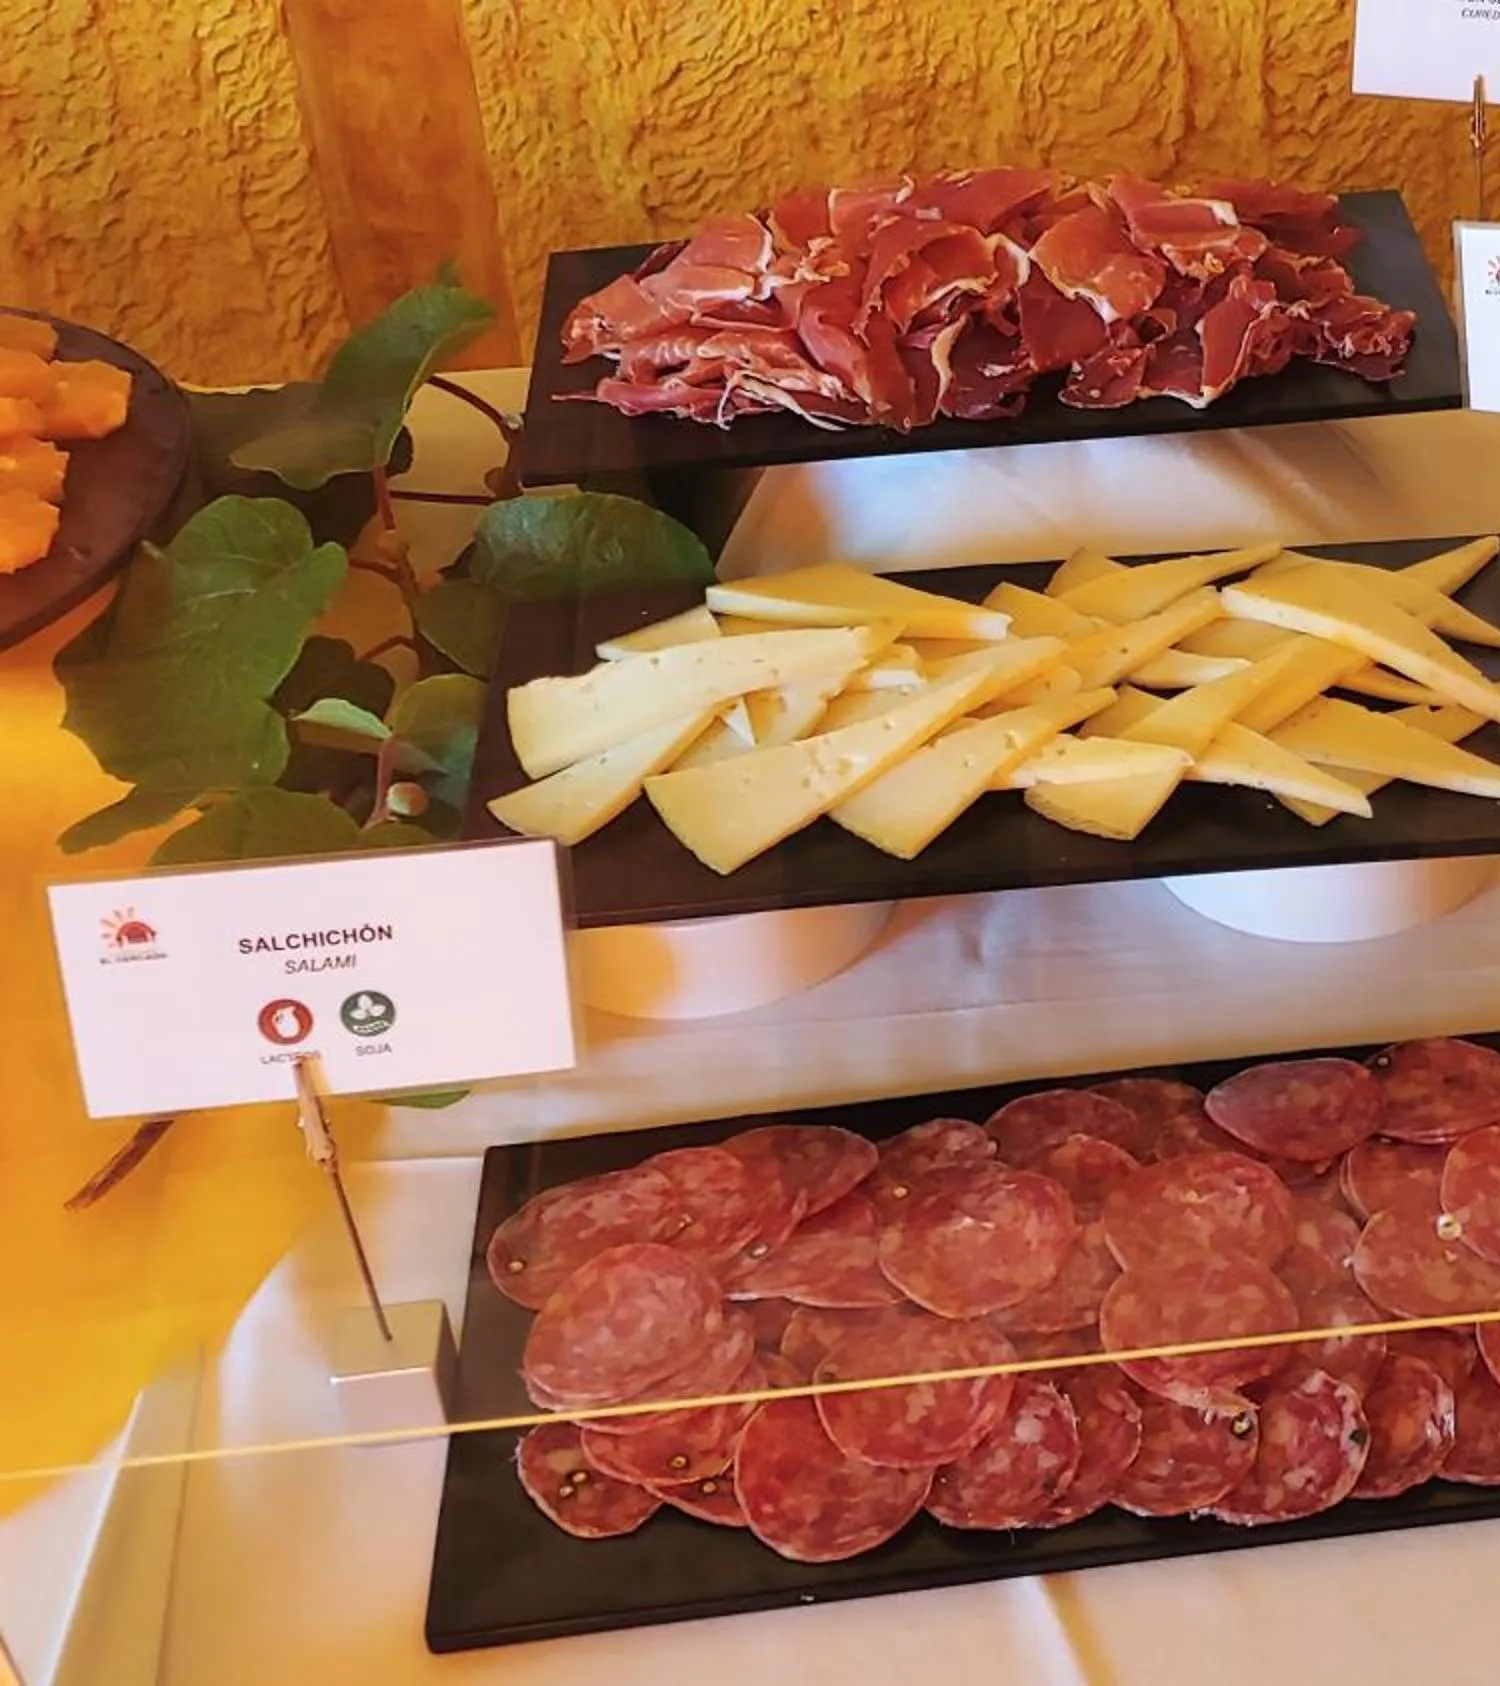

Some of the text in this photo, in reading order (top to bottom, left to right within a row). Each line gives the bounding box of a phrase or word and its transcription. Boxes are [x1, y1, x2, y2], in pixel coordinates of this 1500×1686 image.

[238, 923, 393, 955] SALCHICHÓN
[285, 955, 357, 975] SALAMI
[355, 1043, 393, 1057] SOJA
